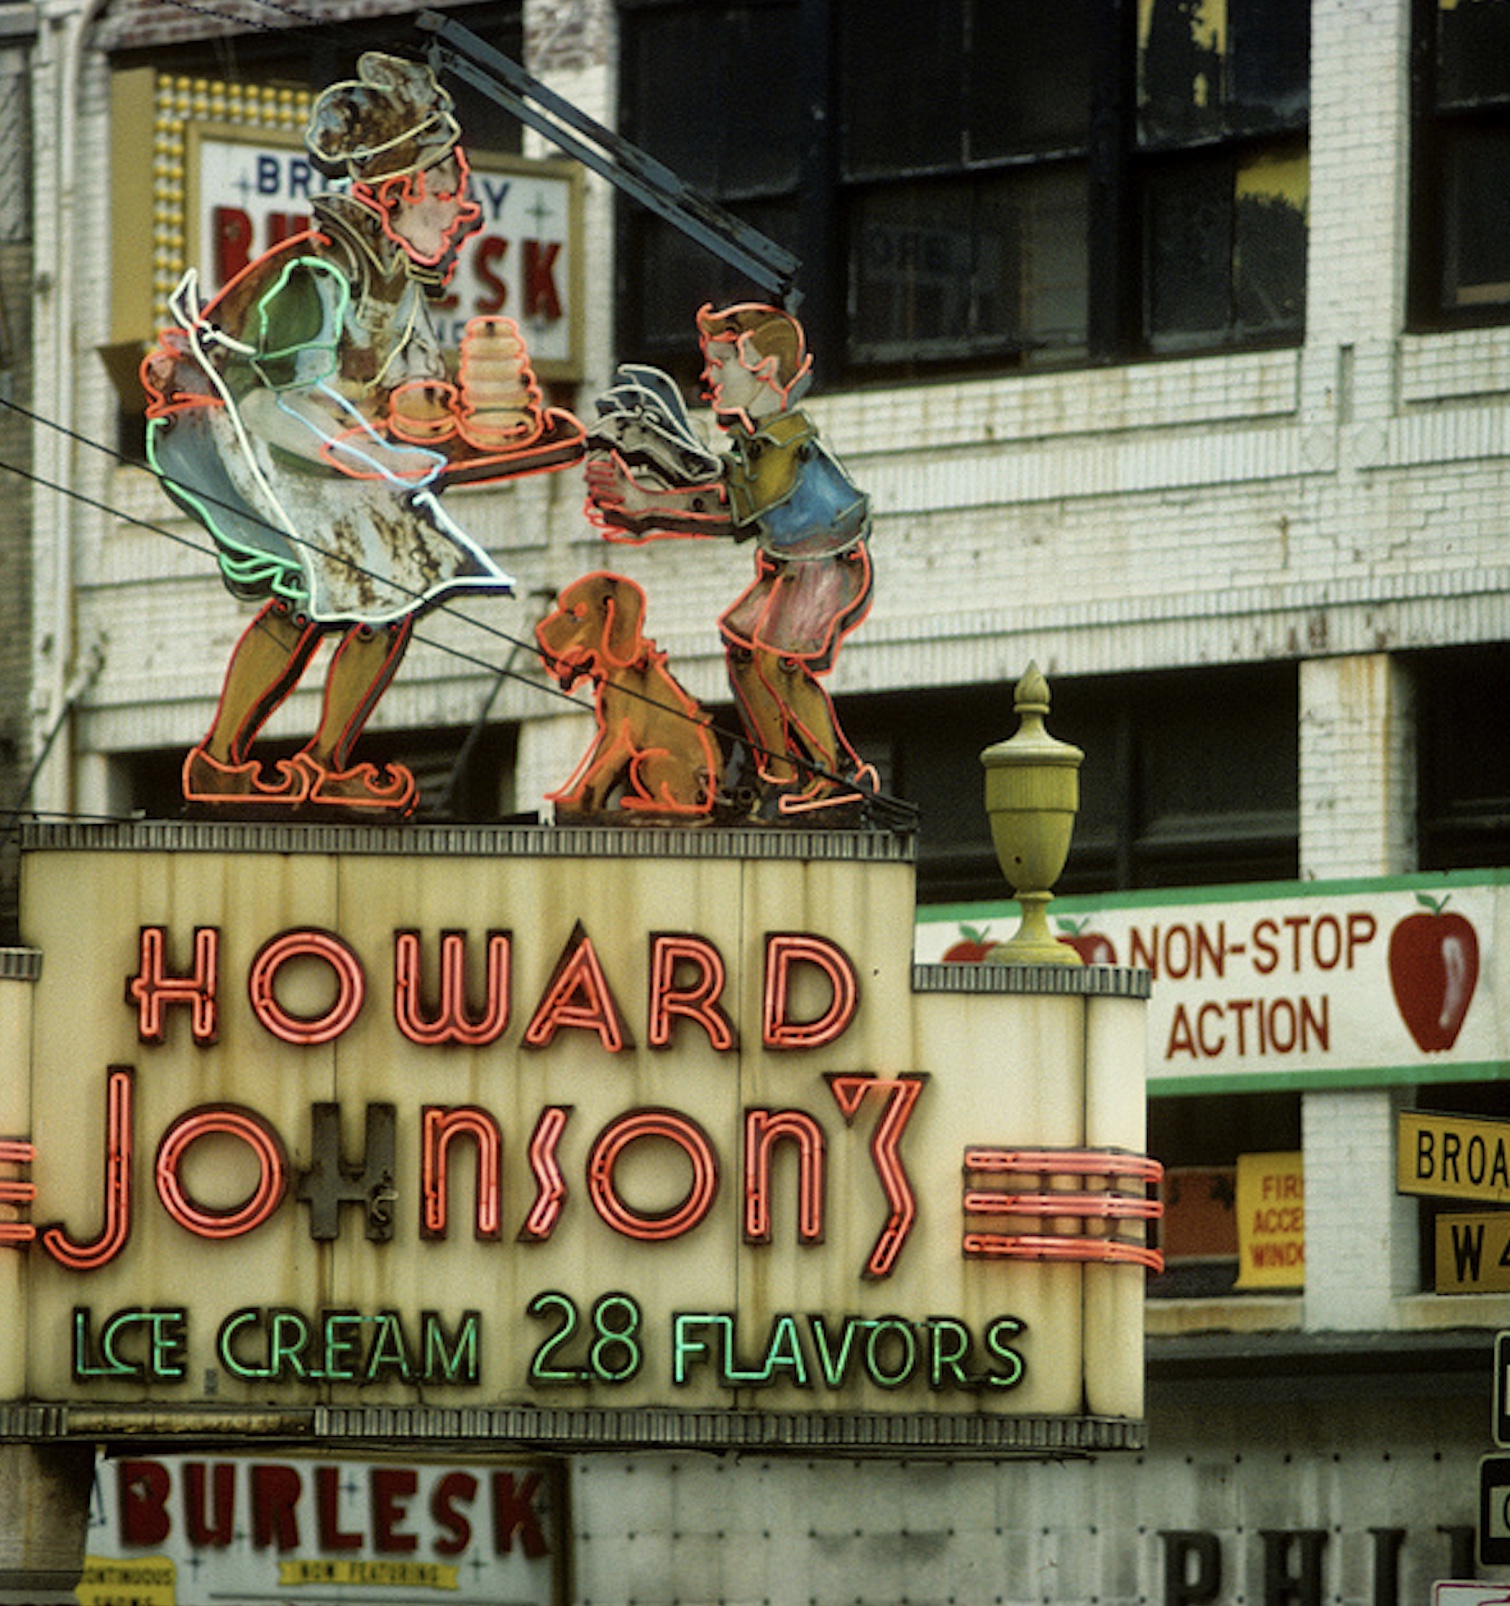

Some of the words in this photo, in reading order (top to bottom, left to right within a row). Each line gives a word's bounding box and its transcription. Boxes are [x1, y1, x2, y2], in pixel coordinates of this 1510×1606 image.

[1129, 911, 1378, 981] NON-STOP
[126, 918, 858, 1051] HOWARD
[1164, 994, 1330, 1061] ACTION
[1416, 1129, 1510, 1189] BROA
[1451, 1223, 1486, 1283] W
[216, 1307, 482, 1386] CREAM
[671, 1310, 1028, 1391] FLAVORS
[115, 1458, 549, 1560] BURLESK
